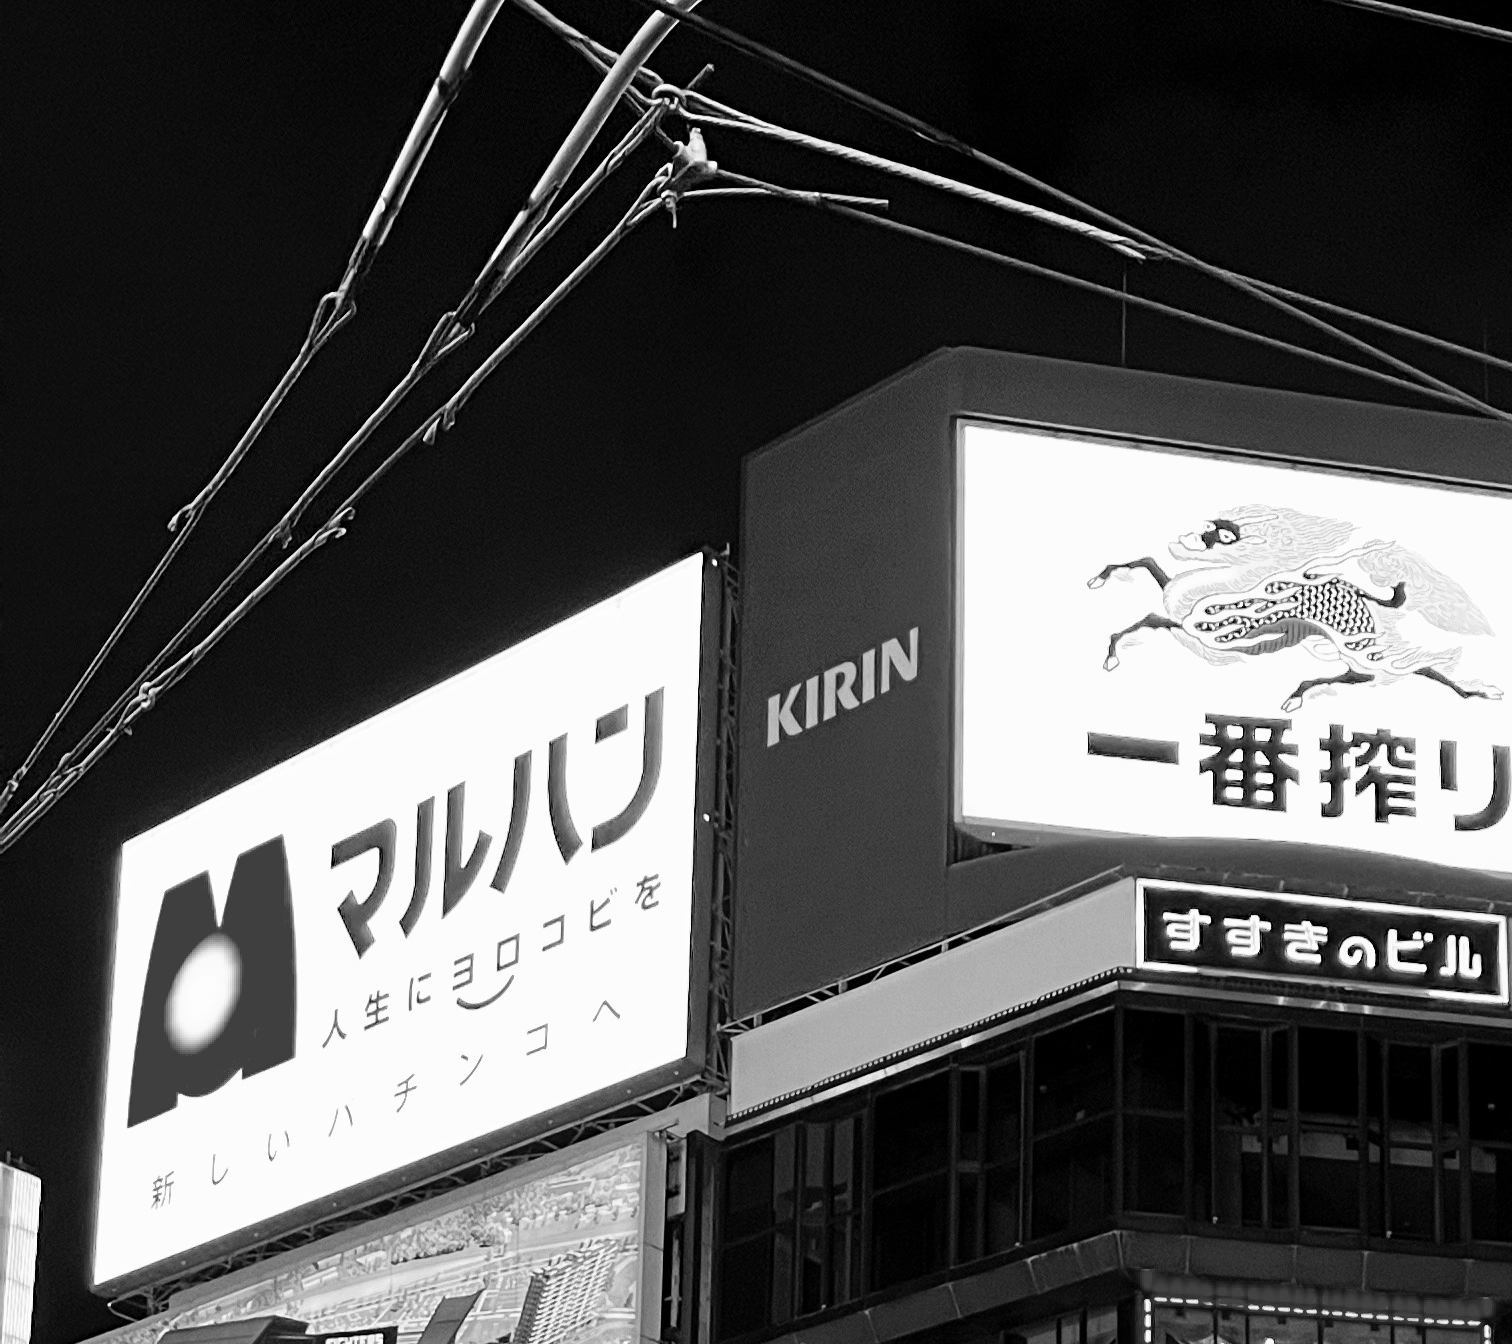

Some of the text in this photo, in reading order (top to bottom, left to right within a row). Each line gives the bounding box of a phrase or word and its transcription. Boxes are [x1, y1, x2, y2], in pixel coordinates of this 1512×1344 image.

[766, 628, 920, 748] KIRIN
[331, 686, 664, 958] マルハン
[1087, 712, 1512, 831] 一番搾り
[322, 874, 661, 1050] 人生にヨロコビを
[1160, 907, 1482, 979] すすきのビル
